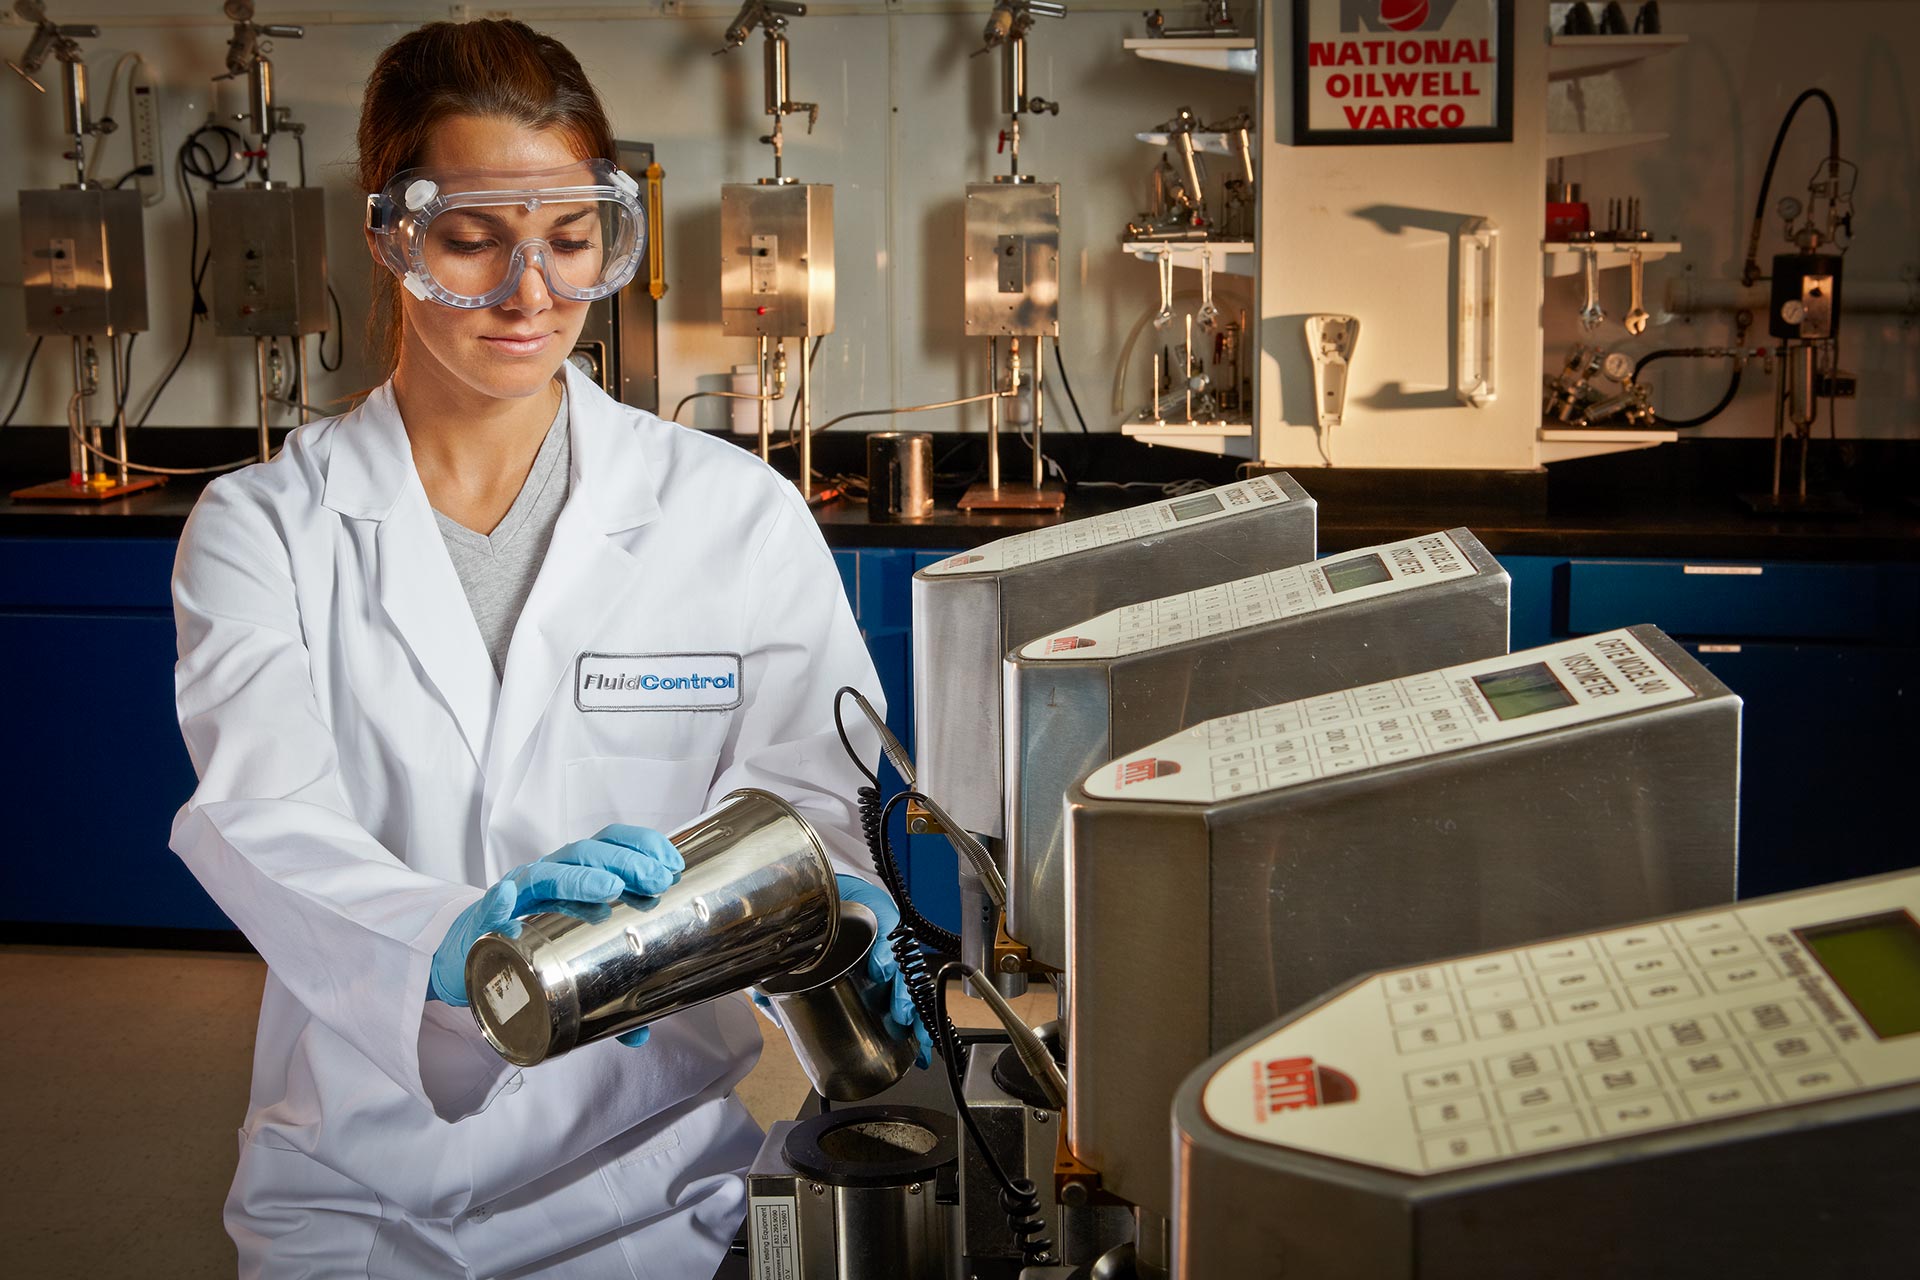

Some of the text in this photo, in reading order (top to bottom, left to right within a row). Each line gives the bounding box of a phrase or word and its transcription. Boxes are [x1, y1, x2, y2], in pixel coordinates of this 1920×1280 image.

[1309, 39, 1496, 67] NATIONAL
[1326, 72, 1480, 98] OILWELL
[1343, 104, 1465, 129] VARCO
[1595, 638, 1671, 695] OFITE MODEL 900
[584, 673, 734, 691] FluidControl
[1560, 652, 1620, 698] VISCOMETER
[1430, 709, 1452, 721] 600
[1378, 718, 1399, 731] 300
[1437, 723, 1457, 732] 60
[1325, 728, 1346, 742] 200
[1383, 733, 1404, 743] 30
[1330, 743, 1350, 754] 20
[1710, 945, 1740, 957] 2
[1727, 970, 1758, 982] 3
[1267, 1056, 1319, 1113] OFITE
[761, 1207, 770, 1240] Equipment
